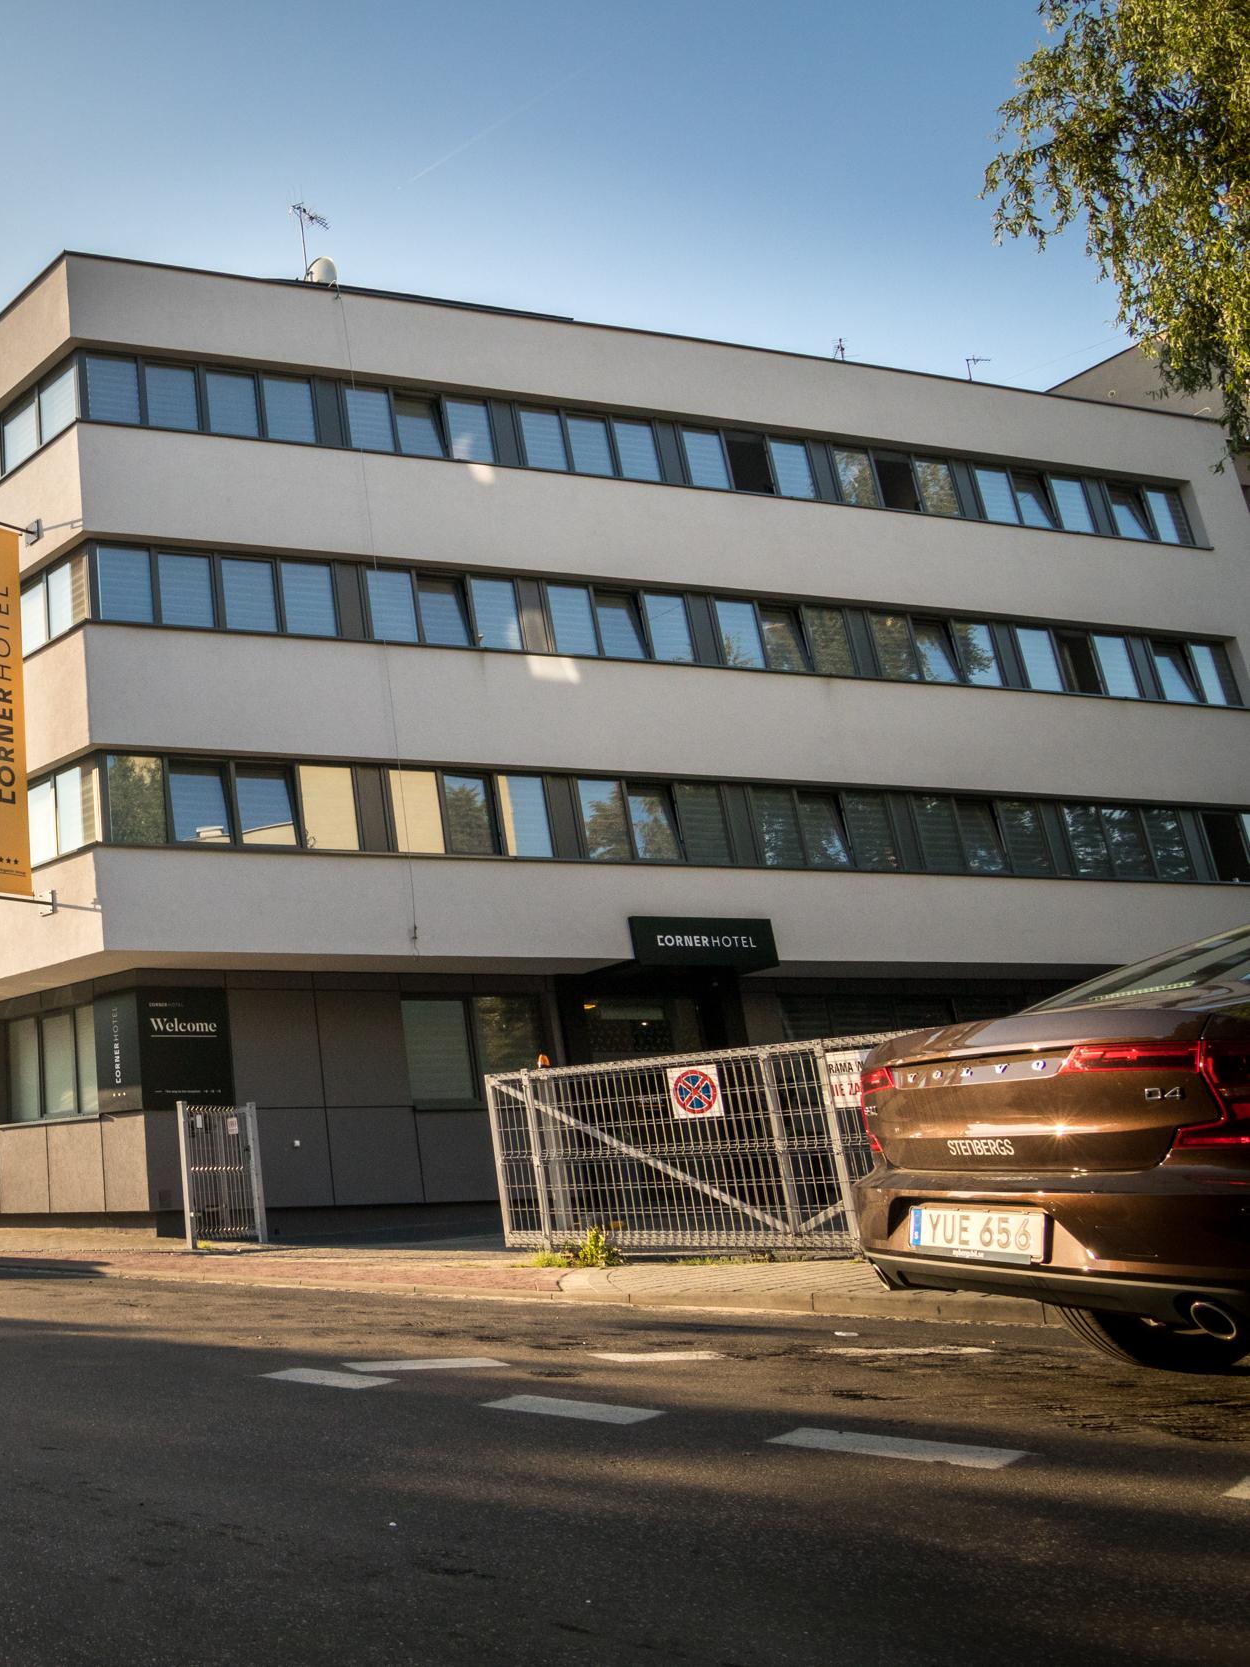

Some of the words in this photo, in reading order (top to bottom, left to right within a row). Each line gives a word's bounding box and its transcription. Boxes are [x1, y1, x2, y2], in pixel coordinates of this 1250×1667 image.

[150, 1017, 217, 1032] Welcome
[828, 1061, 854, 1074] RAMA
[907, 1059, 1047, 1084] VOLVO
[1144, 1086, 1181, 1101] D4
[946, 1138, 1015, 1156] STENBERGS
[929, 1213, 970, 1246] YUE
[979, 1215, 1032, 1251] 656
